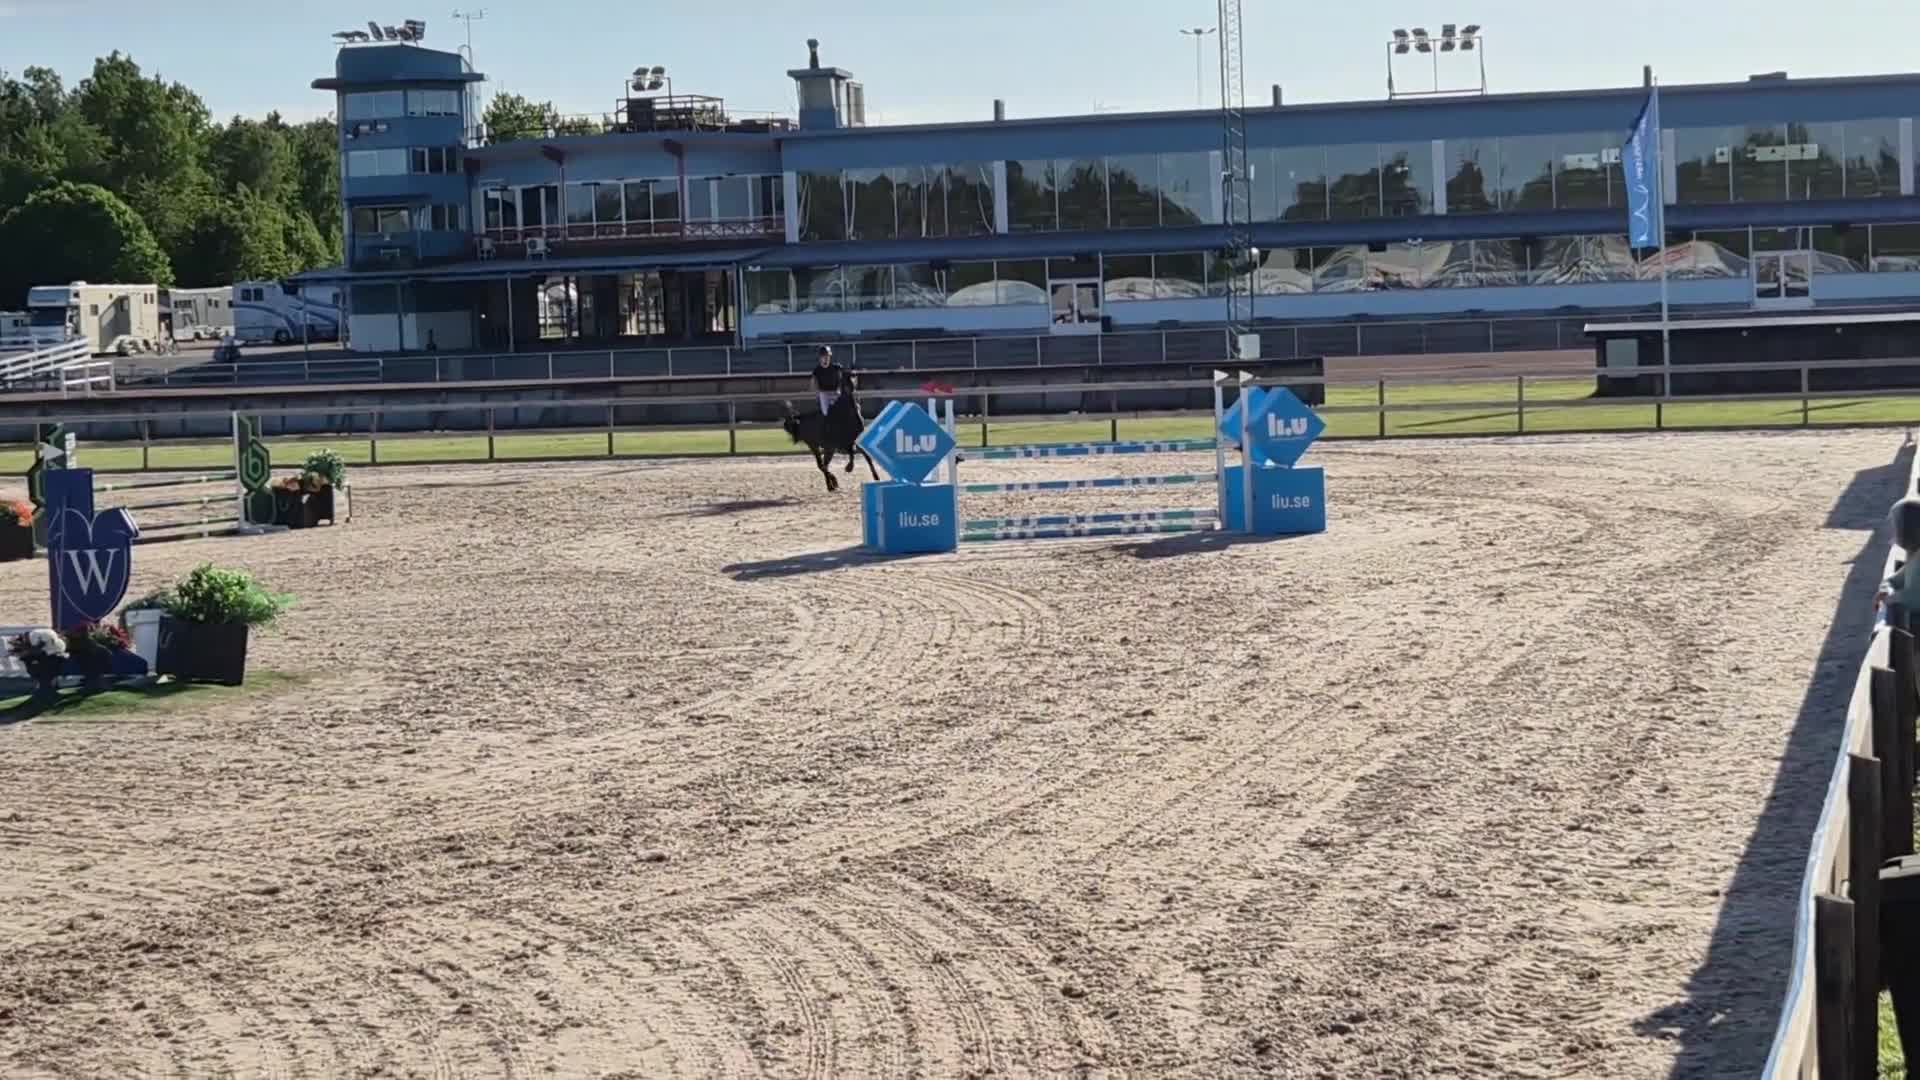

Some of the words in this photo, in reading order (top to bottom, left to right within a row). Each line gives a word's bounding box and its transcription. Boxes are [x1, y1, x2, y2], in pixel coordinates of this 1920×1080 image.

[1271, 493, 1310, 509] liu.se
[899, 511, 940, 527] liu.se
[64, 548, 120, 595] W
